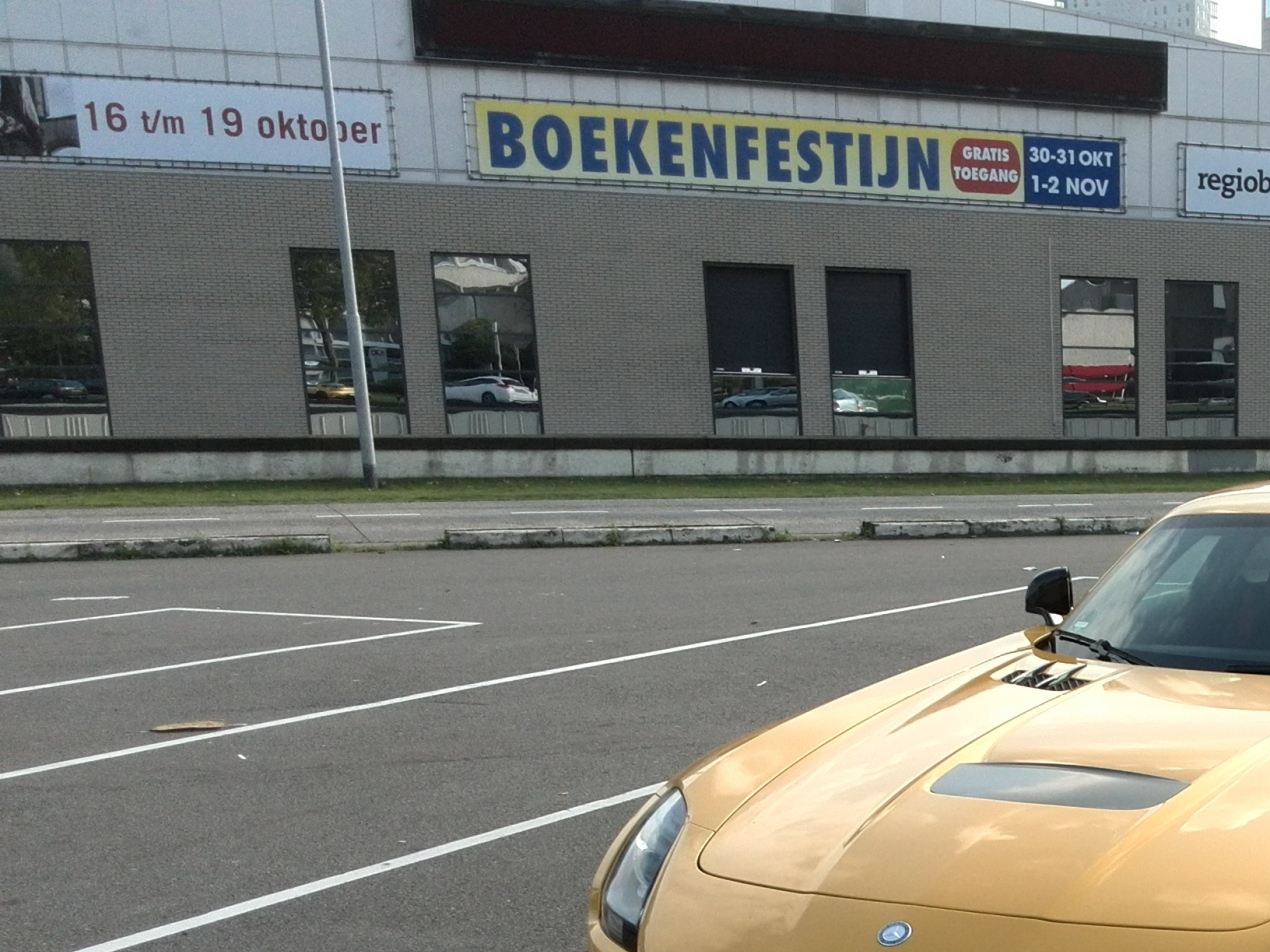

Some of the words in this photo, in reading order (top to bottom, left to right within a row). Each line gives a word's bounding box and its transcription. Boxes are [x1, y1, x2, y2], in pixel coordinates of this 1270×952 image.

[84, 101, 127, 132] 16
[141, 109, 185, 135] t/m
[201, 106, 243, 137] 19
[486, 110, 940, 192] BOEKENFESTIJN
[962, 145, 1010, 162] GRATIS
[1029, 147, 1075, 165] 30-31
[1079, 151, 1113, 167] OKT
[954, 166, 1019, 183] TOEGANG
[1031, 175, 1060, 194] 1-2
[1066, 177, 1109, 196] NOV
